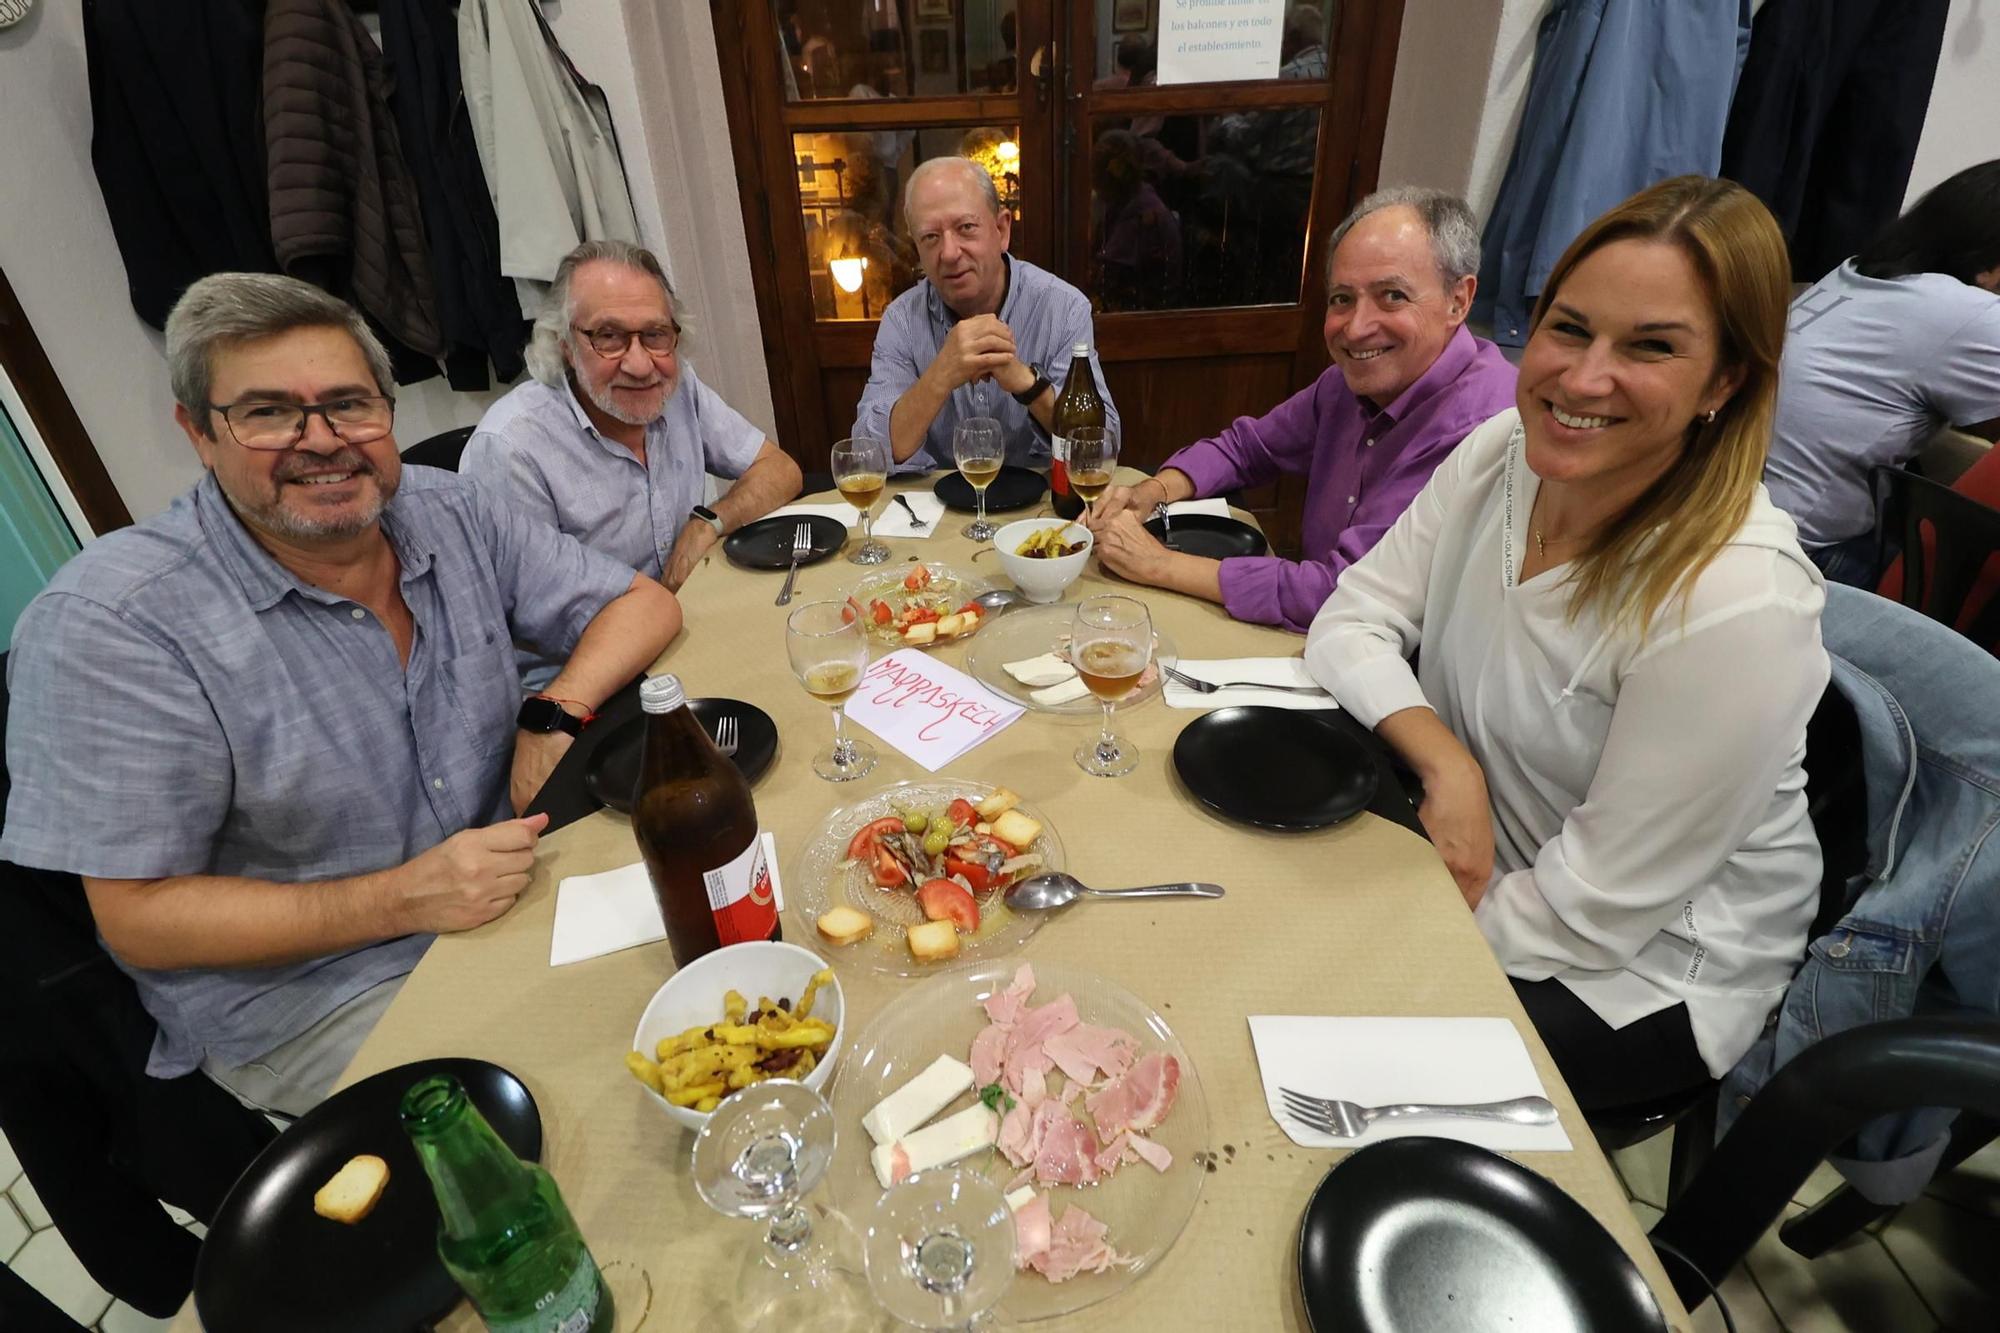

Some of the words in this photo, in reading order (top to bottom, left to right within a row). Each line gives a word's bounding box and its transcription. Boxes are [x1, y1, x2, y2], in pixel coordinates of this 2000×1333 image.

[1171, 20, 1185, 31] los
[1187, 18, 1227, 31] balcones
[1237, 19, 1249, 28] en
[1251, 16, 1272, 27] todo
[1178, 42, 1186, 53] el
